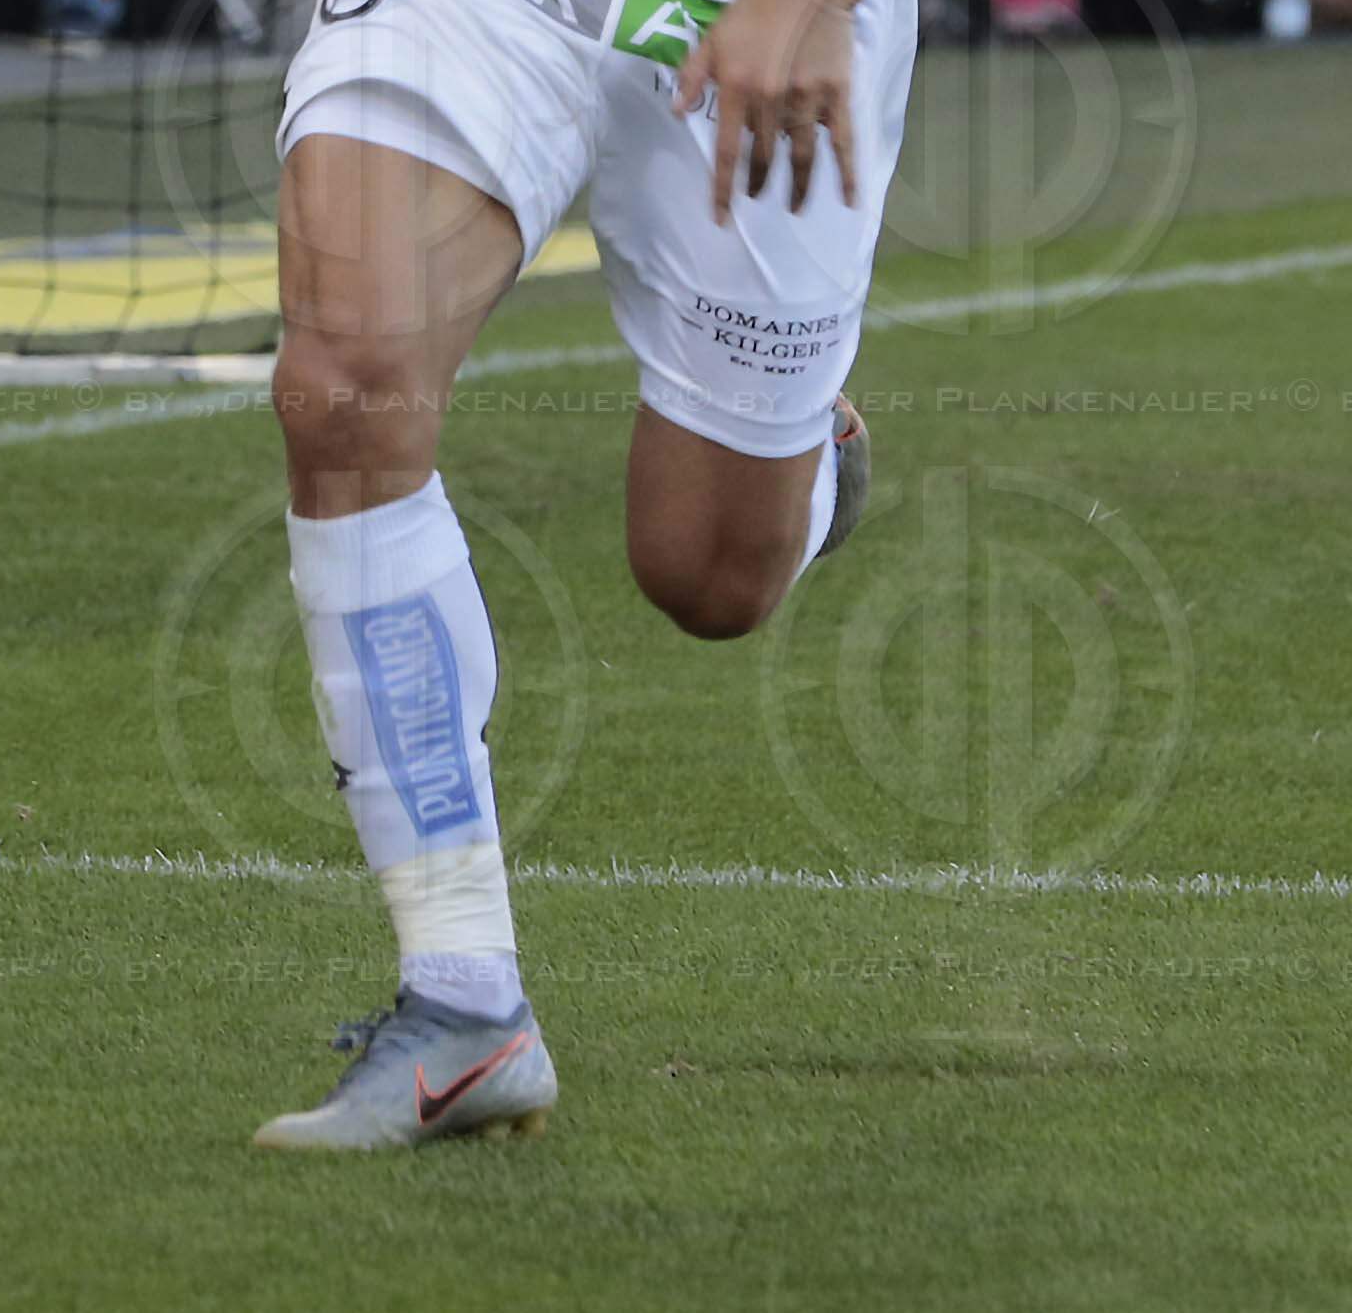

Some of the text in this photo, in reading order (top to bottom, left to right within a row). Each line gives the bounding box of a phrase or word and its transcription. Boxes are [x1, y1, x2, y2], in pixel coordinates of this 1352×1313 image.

[695, 295, 839, 336] DOMAINES
[713, 327, 822, 359] KILGER
[363, 601, 472, 825] PUNTIGAMER
